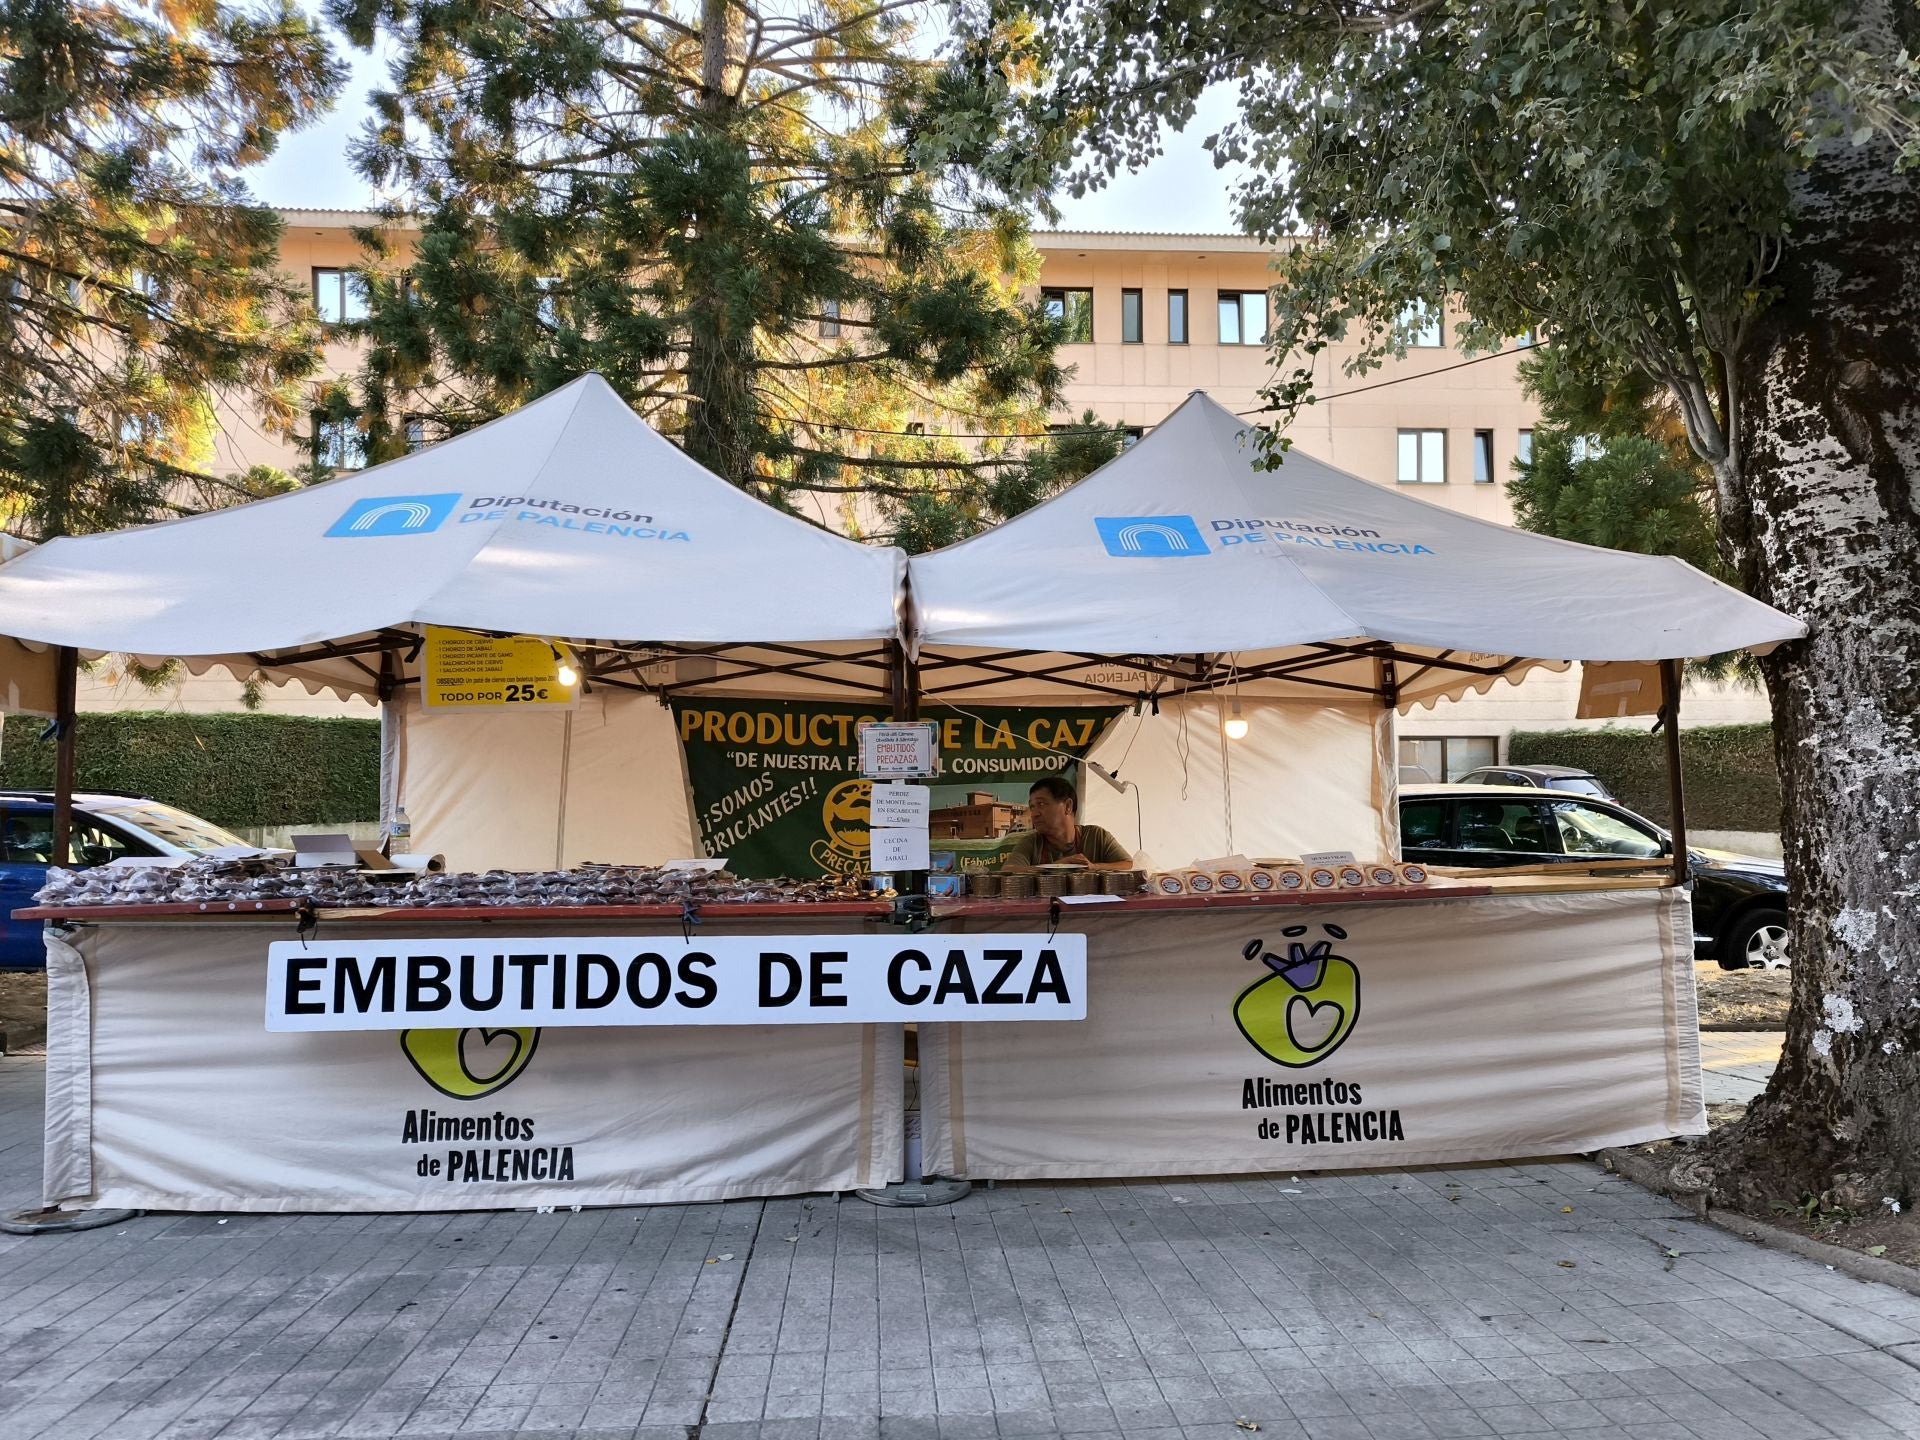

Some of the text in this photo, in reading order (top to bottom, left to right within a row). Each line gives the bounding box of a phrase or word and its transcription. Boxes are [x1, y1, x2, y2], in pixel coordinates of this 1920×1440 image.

[469, 496, 653, 524] Diputación
[458, 510, 691, 542] DE PALENCIA
[1210, 518, 1382, 538] Diputación
[1219, 532, 1437, 555] DE PALENCIA
[440, 693, 474, 701] TODO
[477, 692, 502, 700] POR
[681, 710, 894, 746] PRODUCT
[975, 719, 1016, 749] LA
[1027, 717, 1112, 749] CAZ
[764, 754, 842, 771] NUESTRA
[876, 743, 916, 753] EMBUTIDOS
[876, 755, 918, 765] PRECAZASA
[284, 948, 1071, 1016] EMBUTIDOS DE CAZA
[1242, 1077, 1363, 1110] Alimentos
[402, 1109, 535, 1144] Alimentos
[1258, 1110, 1406, 1145] de PALENCIA
[417, 1147, 575, 1183] de PALENCIA
